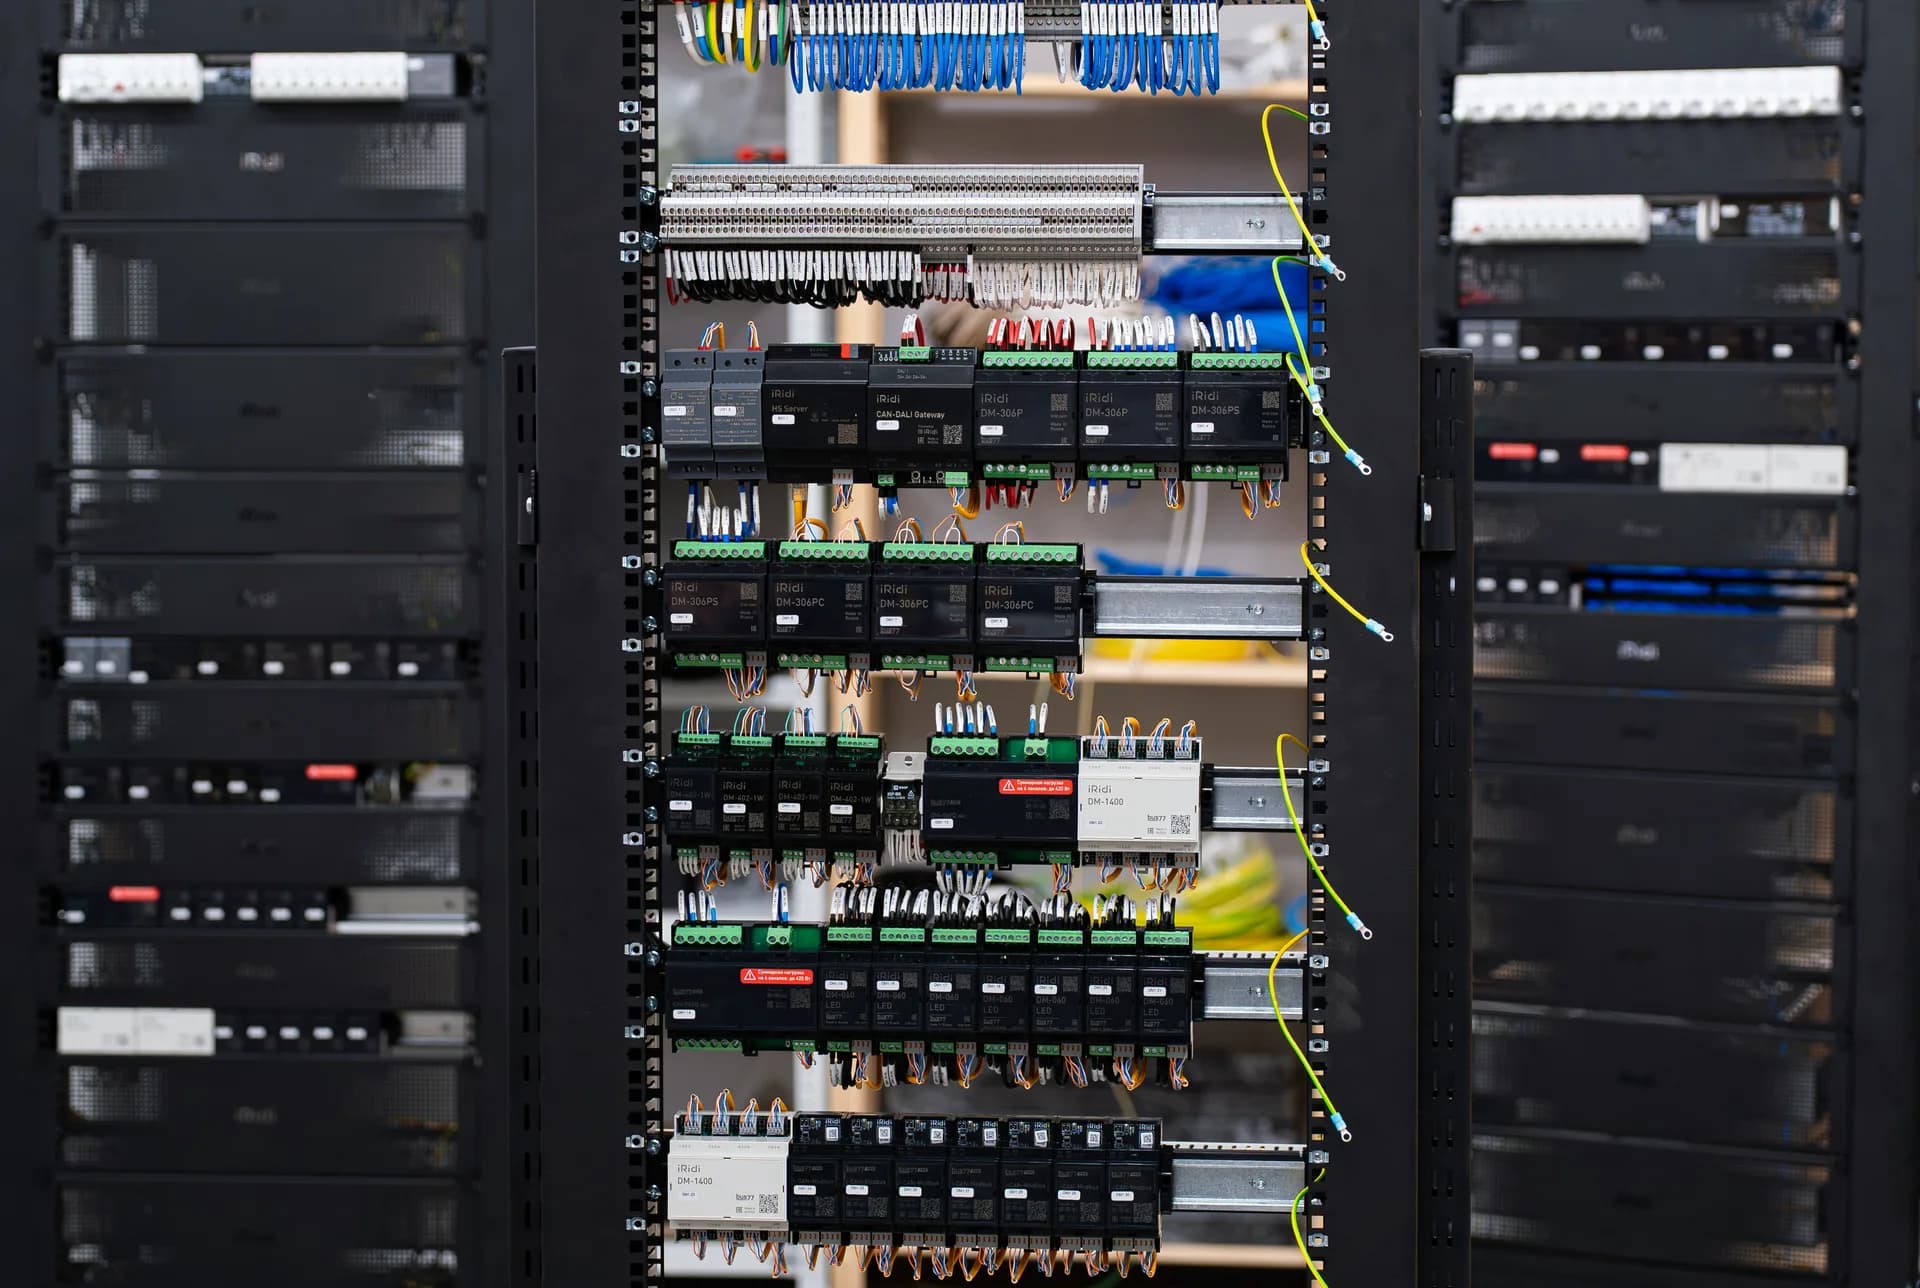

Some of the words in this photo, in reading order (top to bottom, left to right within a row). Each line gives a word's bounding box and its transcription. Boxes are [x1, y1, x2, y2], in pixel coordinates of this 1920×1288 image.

[770, 389, 795, 399] iRidi
[876, 394, 900, 404] iRidi
[981, 393, 1008, 404] iRidi
[1085, 393, 1114, 404] iRidi
[1191, 391, 1219, 401] iRidi
[784, 404, 808, 412] Server
[980, 408, 1024, 418] DM-306P
[1085, 408, 1128, 417] DM-306P
[1191, 406, 1240, 415] DM-306PS
[914, 411, 945, 420] Gateway
[671, 582, 698, 592] iRidi
[776, 583, 804, 593] iRidi
[880, 584, 908, 595] iRidi
[984, 585, 1012, 596] iRidi
[671, 597, 719, 607] DM-306PS
[776, 597, 825, 607] DM-306PC
[880, 599, 929, 609] DM-306PC
[984, 600, 1034, 610] DM-306PC
[670, 778, 694, 787] iRidi
[723, 781, 747, 791] iRidi
[778, 780, 802, 790] iRidi
[830, 782, 854, 792] iRidi
[1088, 785, 1112, 794] iRidi
[1088, 798, 1124, 806] DM-1400
[877, 1002, 893, 1010] LED
[929, 1004, 945, 1012] LED
[983, 1006, 999, 1014] LED
[1036, 1007, 1052, 1015] LED
[1090, 1007, 1106, 1015] LED
[677, 1164, 701, 1174] iRidi
[677, 1177, 713, 1186] DM-1400
